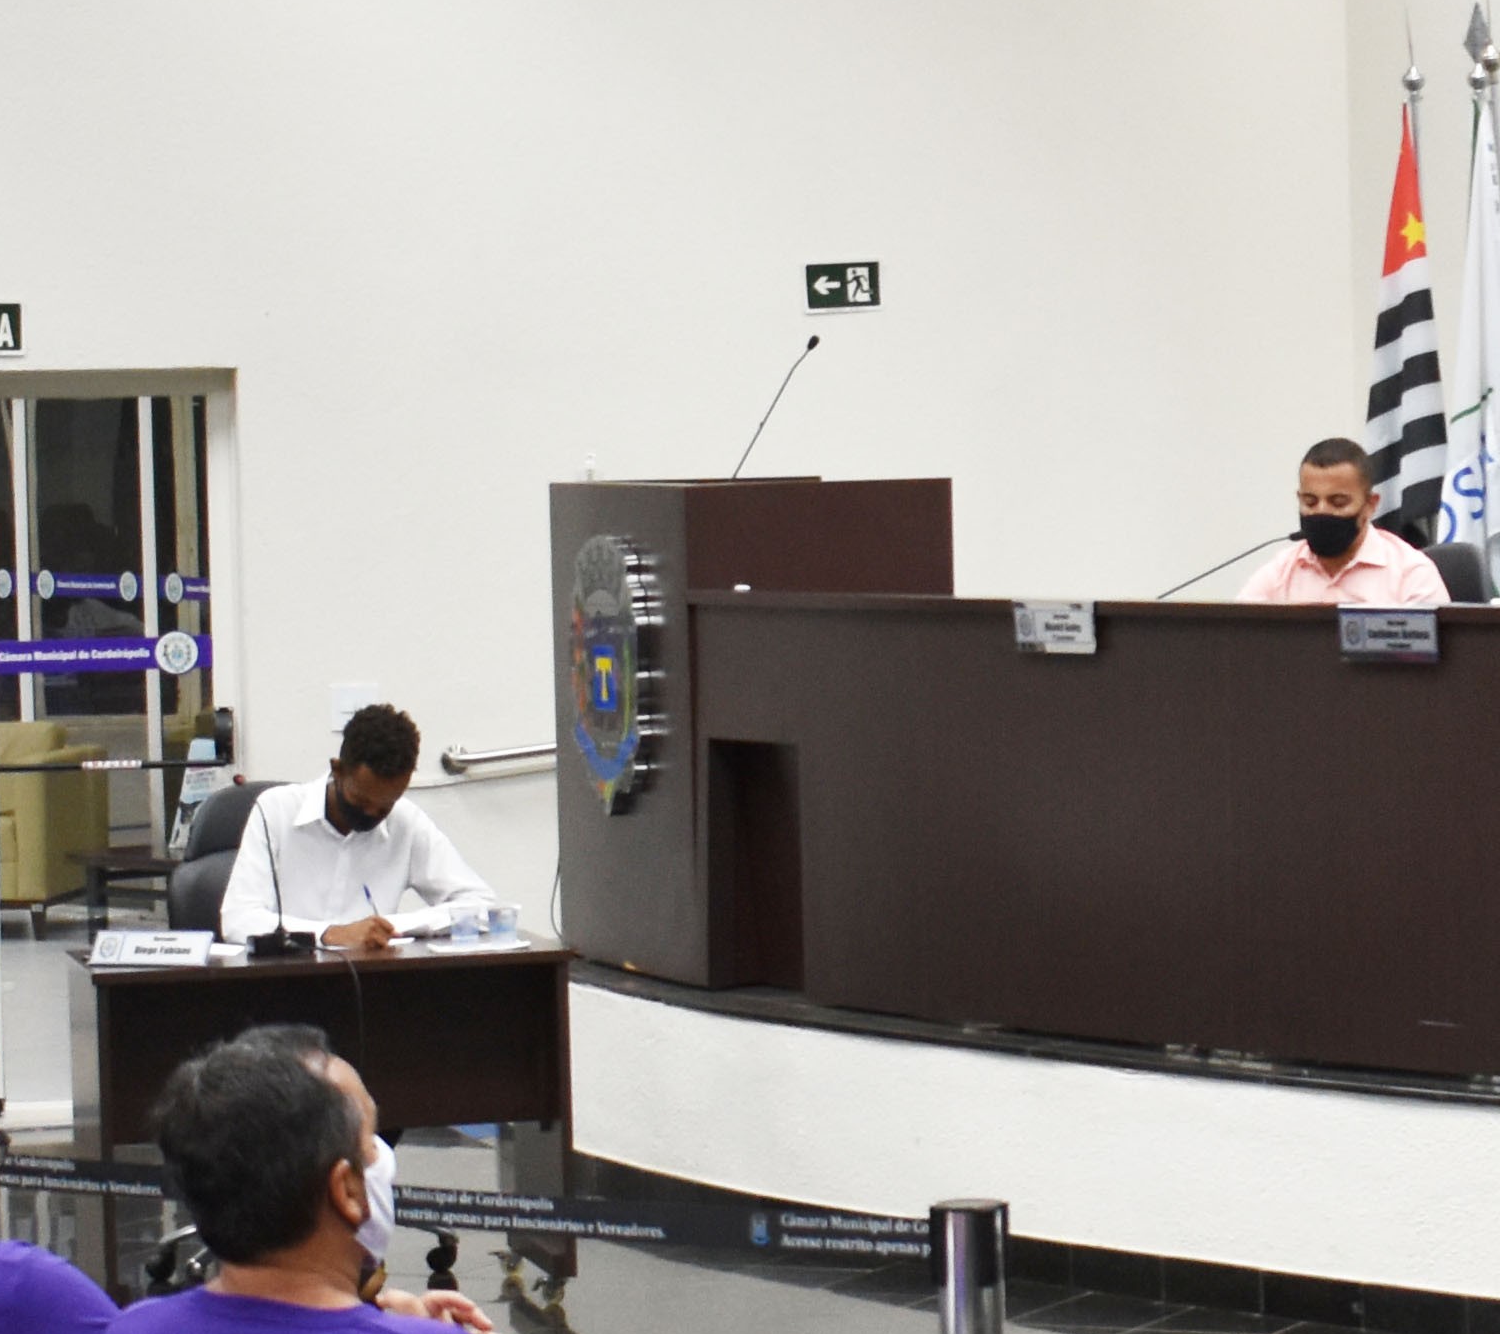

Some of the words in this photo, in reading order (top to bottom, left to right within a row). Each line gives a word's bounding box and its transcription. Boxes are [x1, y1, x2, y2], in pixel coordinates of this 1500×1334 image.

[402, 1187, 457, 1205] Municipal
[443, 1212, 482, 1225] apenas
[485, 1215, 510, 1228] para
[781, 1211, 828, 1228] Câmara
[831, 1215, 893, 1234] Municipal
[895, 1220, 909, 1232] de
[781, 1234, 821, 1247] Acesso
[825, 1236, 873, 1251] restrito
[876, 1241, 919, 1256] apenas
